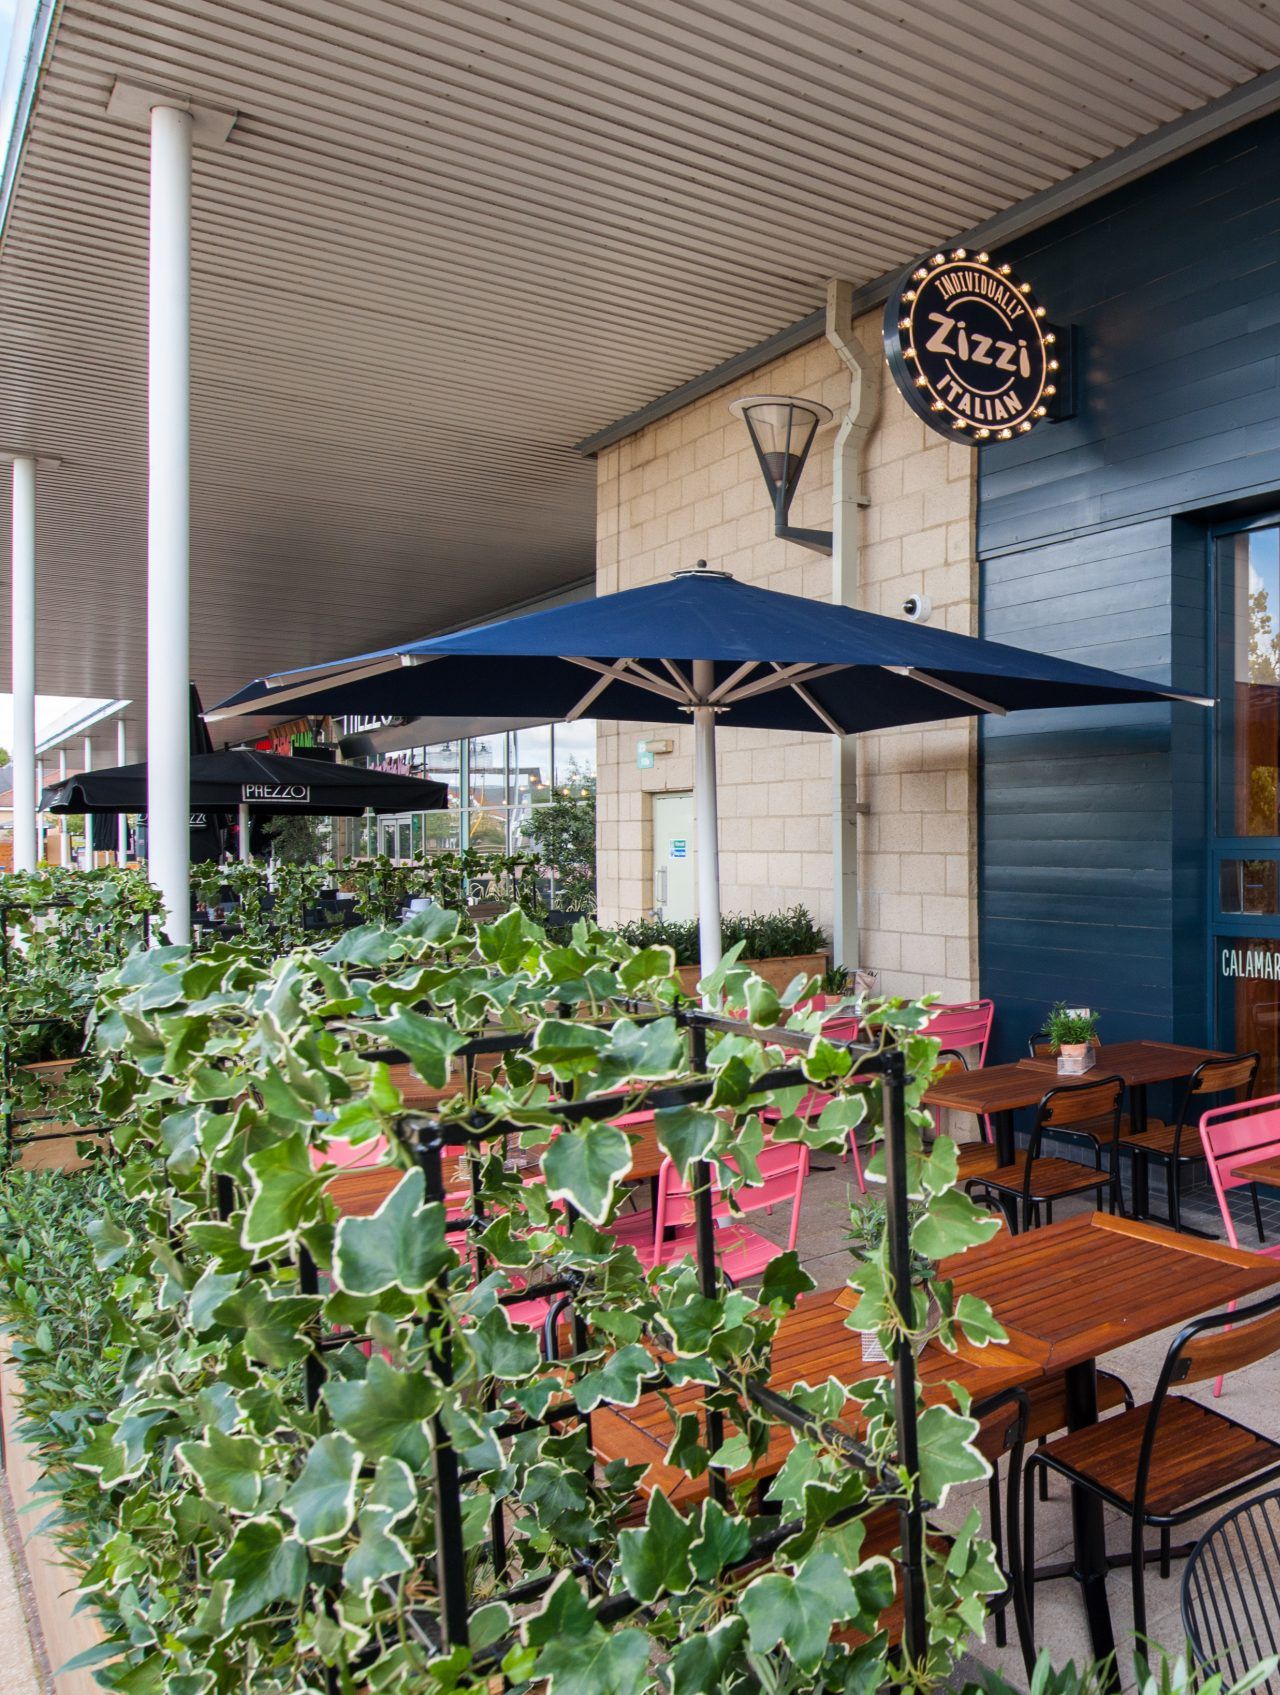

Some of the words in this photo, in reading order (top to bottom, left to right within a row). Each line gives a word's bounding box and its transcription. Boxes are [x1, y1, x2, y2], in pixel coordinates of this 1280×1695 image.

[934, 270, 1025, 319] INDIVIDUALLY
[925, 312, 1031, 378] Zizzi
[936, 374, 1023, 420] ITALIAN
[246, 784, 306, 798] PREZZO
